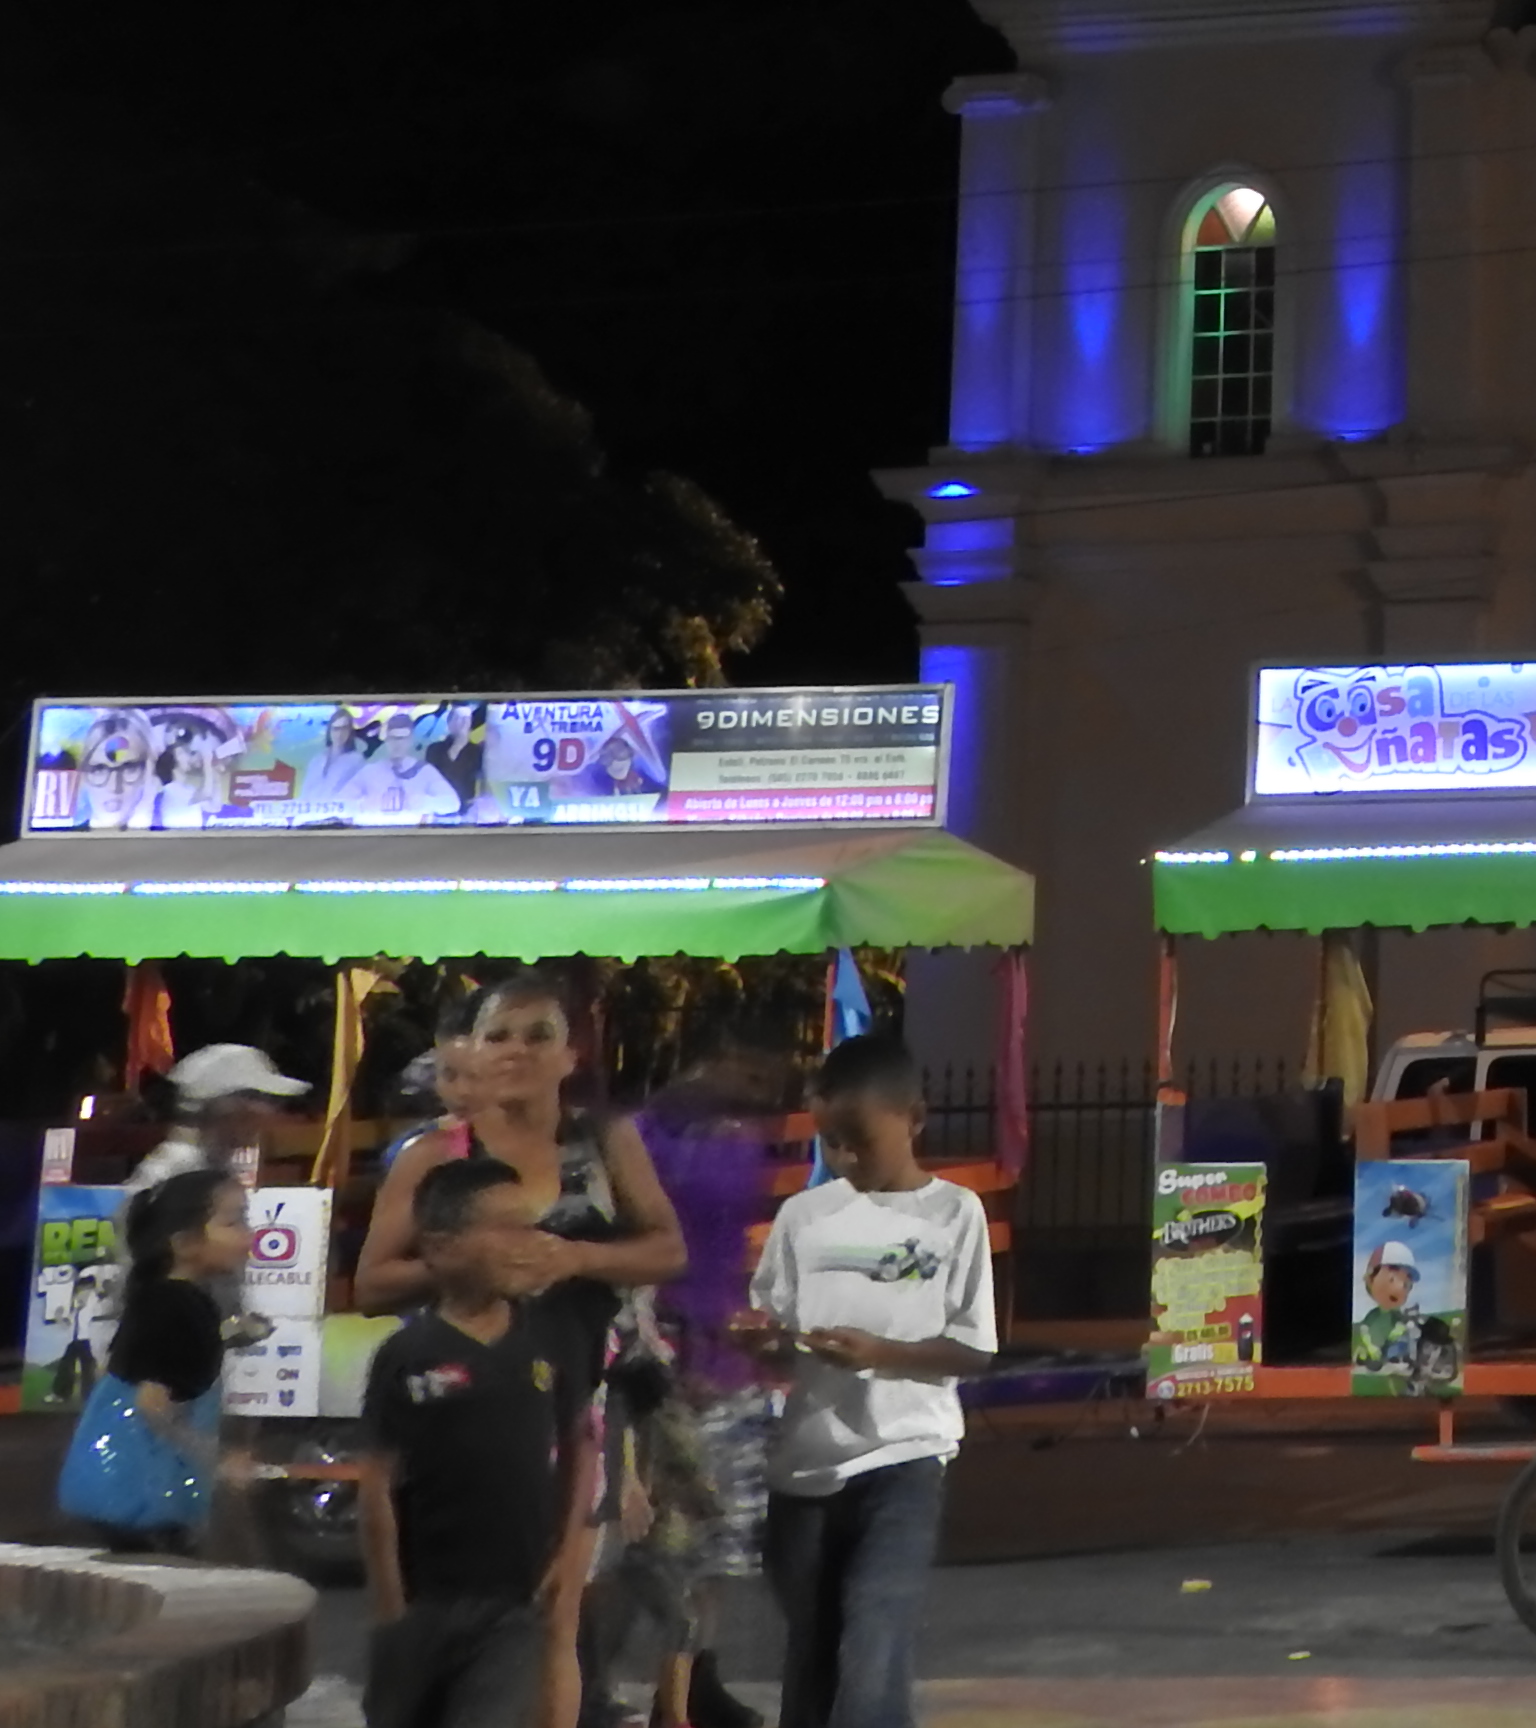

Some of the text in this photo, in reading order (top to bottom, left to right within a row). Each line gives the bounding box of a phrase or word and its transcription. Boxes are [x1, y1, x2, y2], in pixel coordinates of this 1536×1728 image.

[502, 700, 603, 720] AVENTURA
[697, 705, 940, 729] 9DIMENSIONES
[533, 738, 585, 772] 9D
[509, 786, 540, 807] YA
[1158, 1168, 1227, 1194] Super
[250, 1272, 312, 1285] LECABLE
